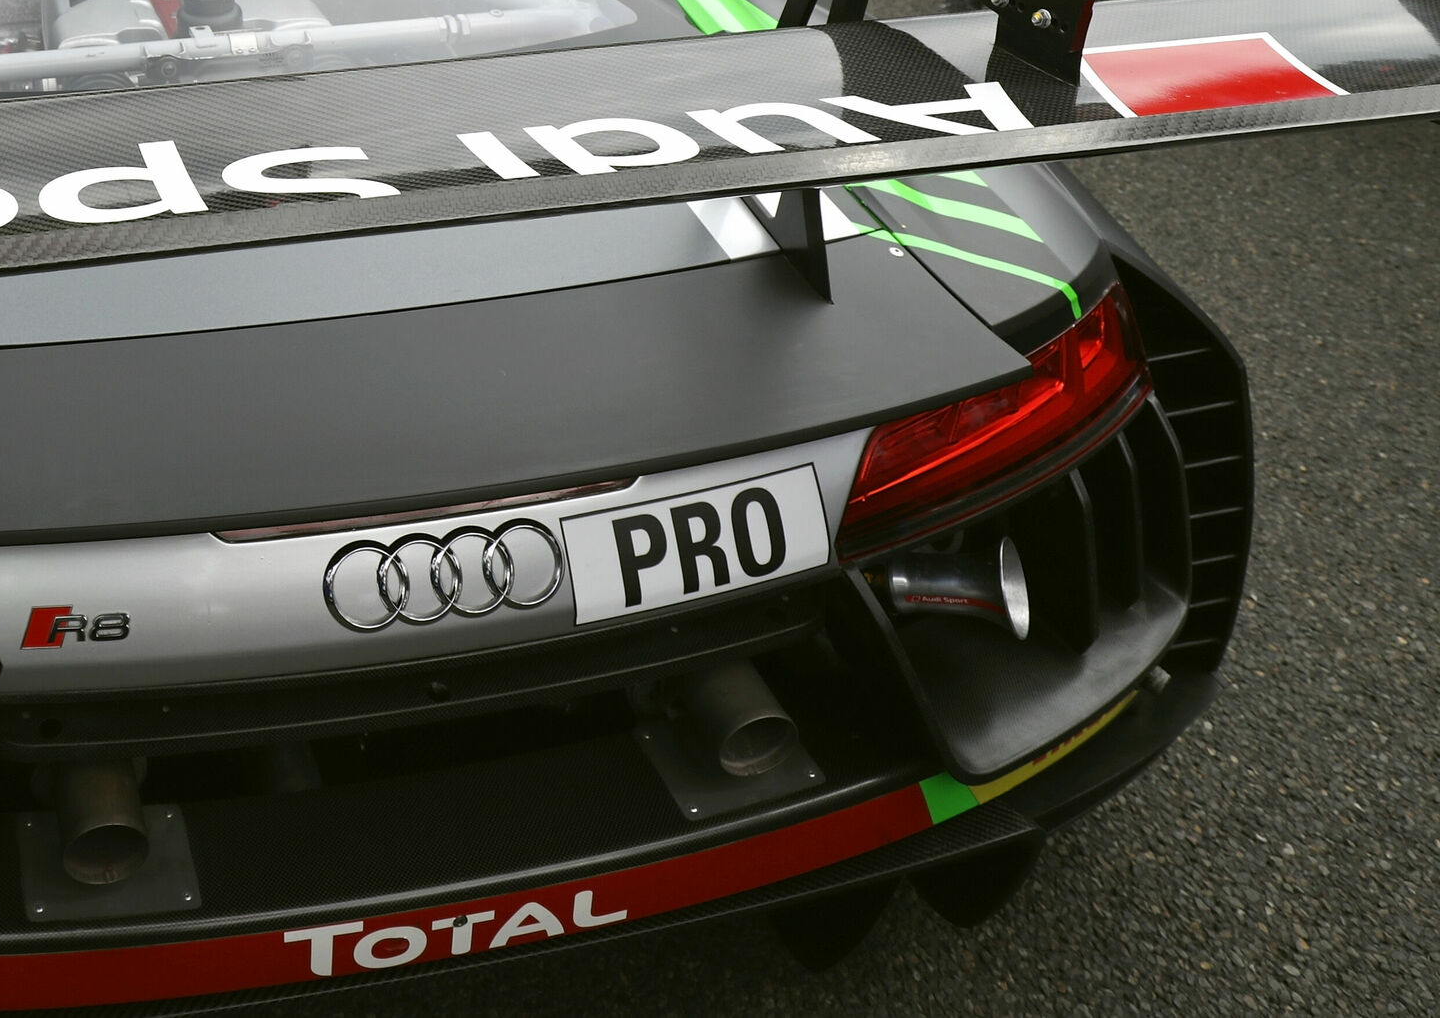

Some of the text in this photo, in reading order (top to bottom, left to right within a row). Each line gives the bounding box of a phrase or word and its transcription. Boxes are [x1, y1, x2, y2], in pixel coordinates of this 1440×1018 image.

[612, 487, 786, 608] PRO
[47, 613, 131, 643] R8
[921, 595, 969, 605] Audi Sport
[284, 890, 628, 977] TOTAL
